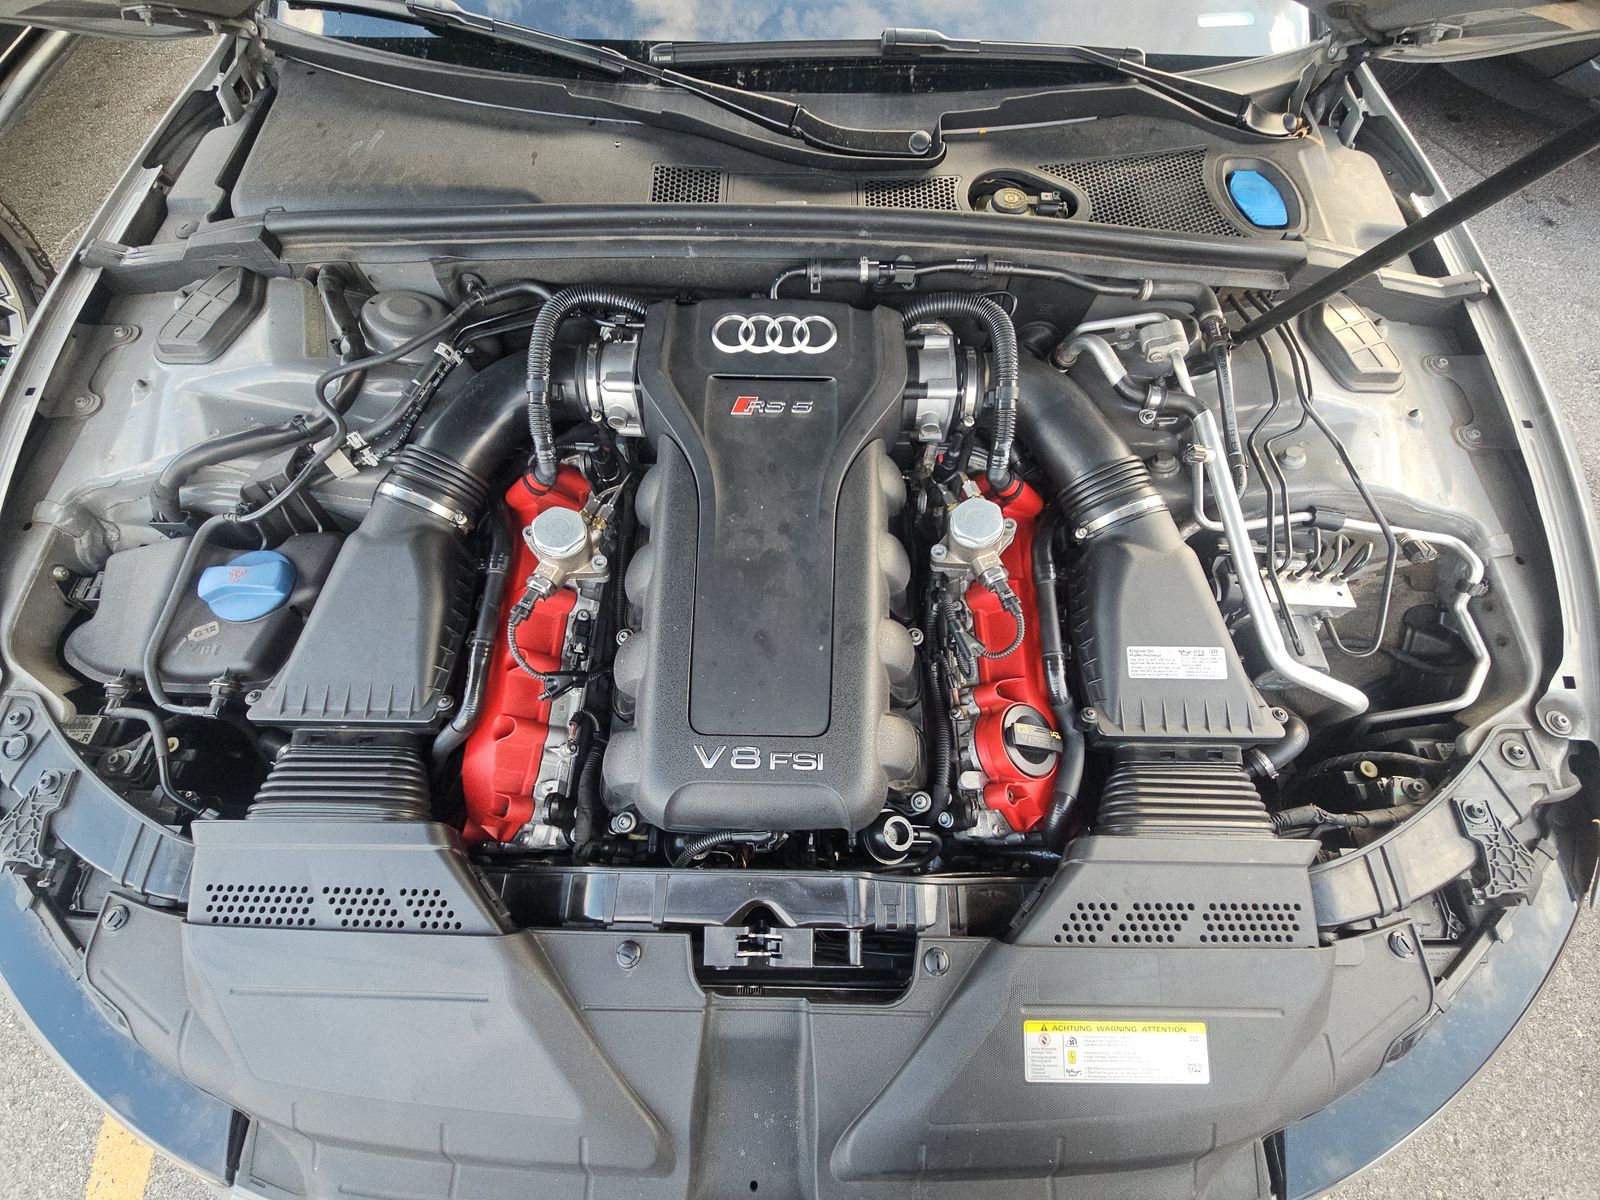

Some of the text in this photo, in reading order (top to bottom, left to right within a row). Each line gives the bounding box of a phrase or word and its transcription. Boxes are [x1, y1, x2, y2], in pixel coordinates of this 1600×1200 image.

[739, 399, 814, 414] RS 5
[693, 745, 824, 771] V8 FSI
